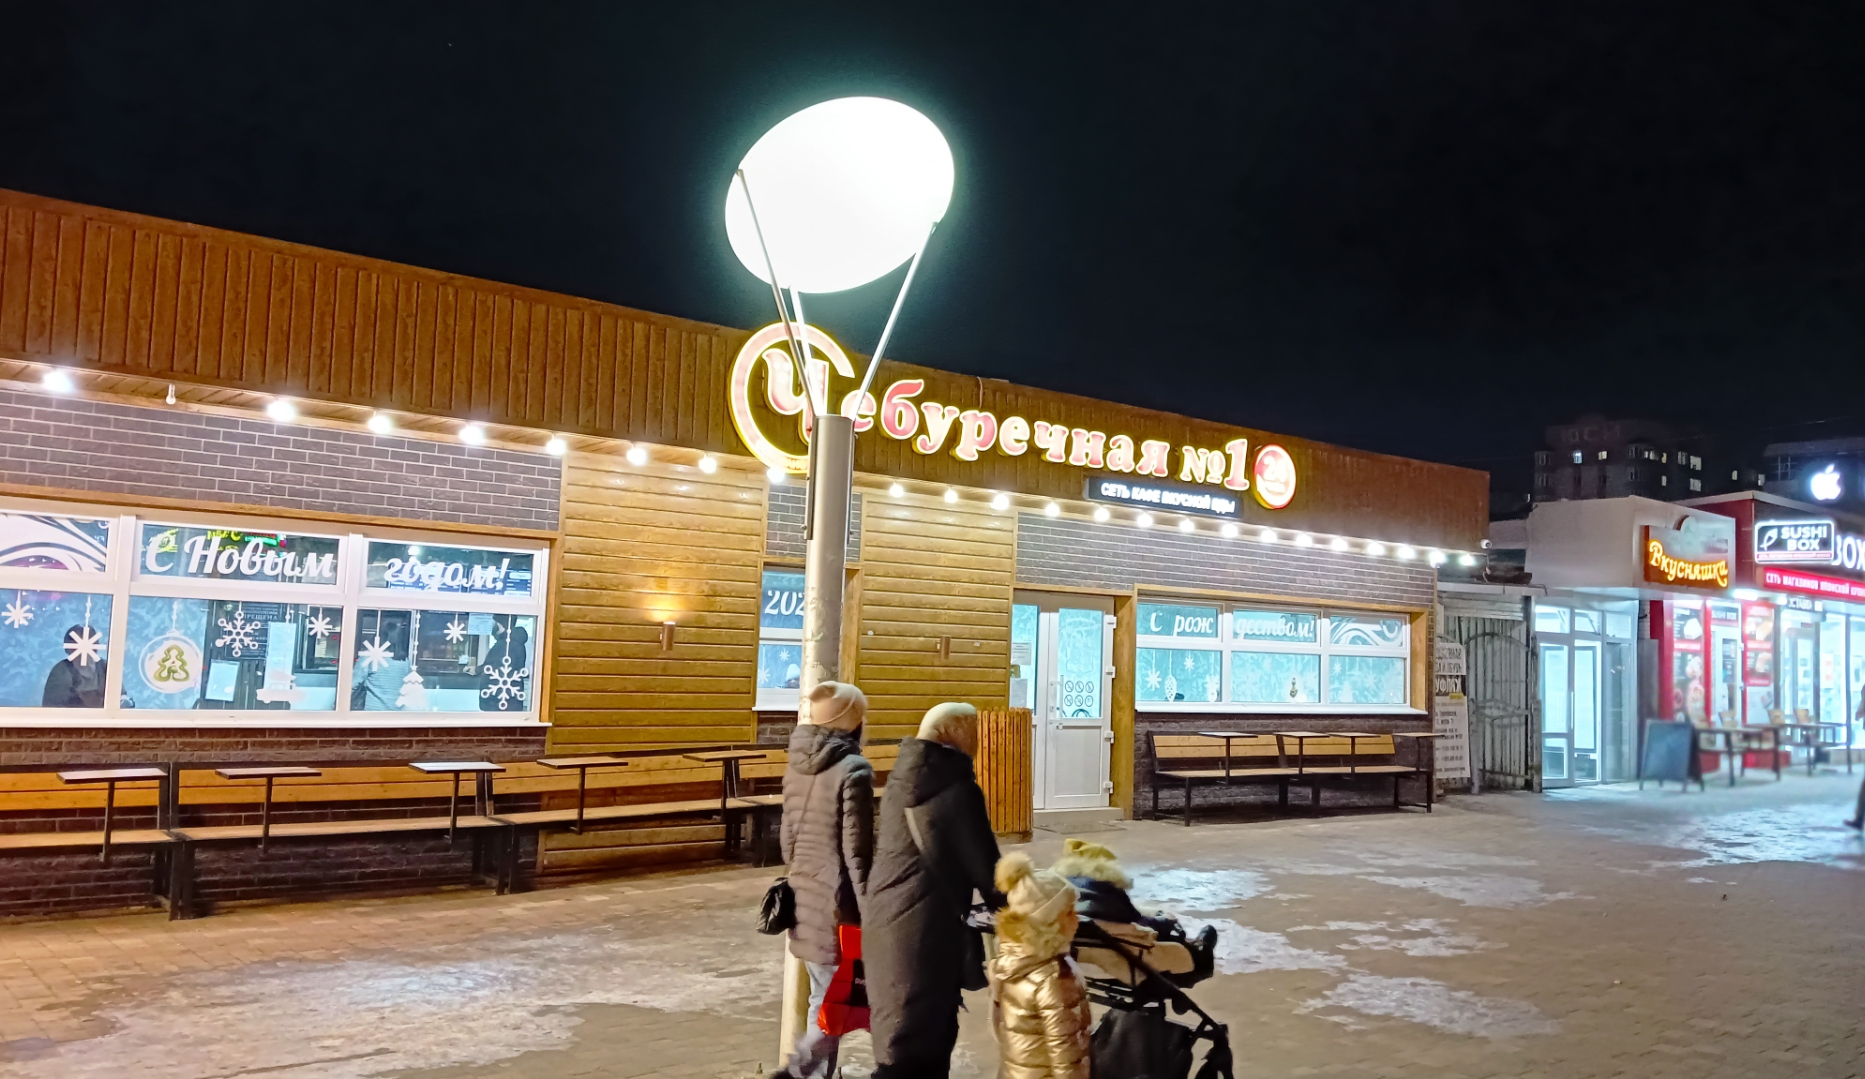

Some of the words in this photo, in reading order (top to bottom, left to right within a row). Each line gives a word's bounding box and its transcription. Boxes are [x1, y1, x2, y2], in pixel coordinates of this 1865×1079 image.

[731, 321, 1170, 477] Чебуречная
[1179, 438, 1250, 490] №1
[1101, 482, 1130, 499] СЕТЬ
[1131, 487, 1160, 503] КАФЕ
[1162, 490, 1211, 509] ВКУСНОЙ
[1781, 526, 1827, 540] SUSHI
[1787, 538, 1820, 551] BOX
[146, 531, 174, 573] С
[183, 535, 335, 578] Новым
[384, 557, 510, 592] годом!
[1649, 540, 1729, 588] Вкусняшка
[1766, 572, 1781, 584] СЕТЬ
[1783, 575, 1819, 590] МАГАЗИНОВ
[1150, 612, 1164, 632] С
